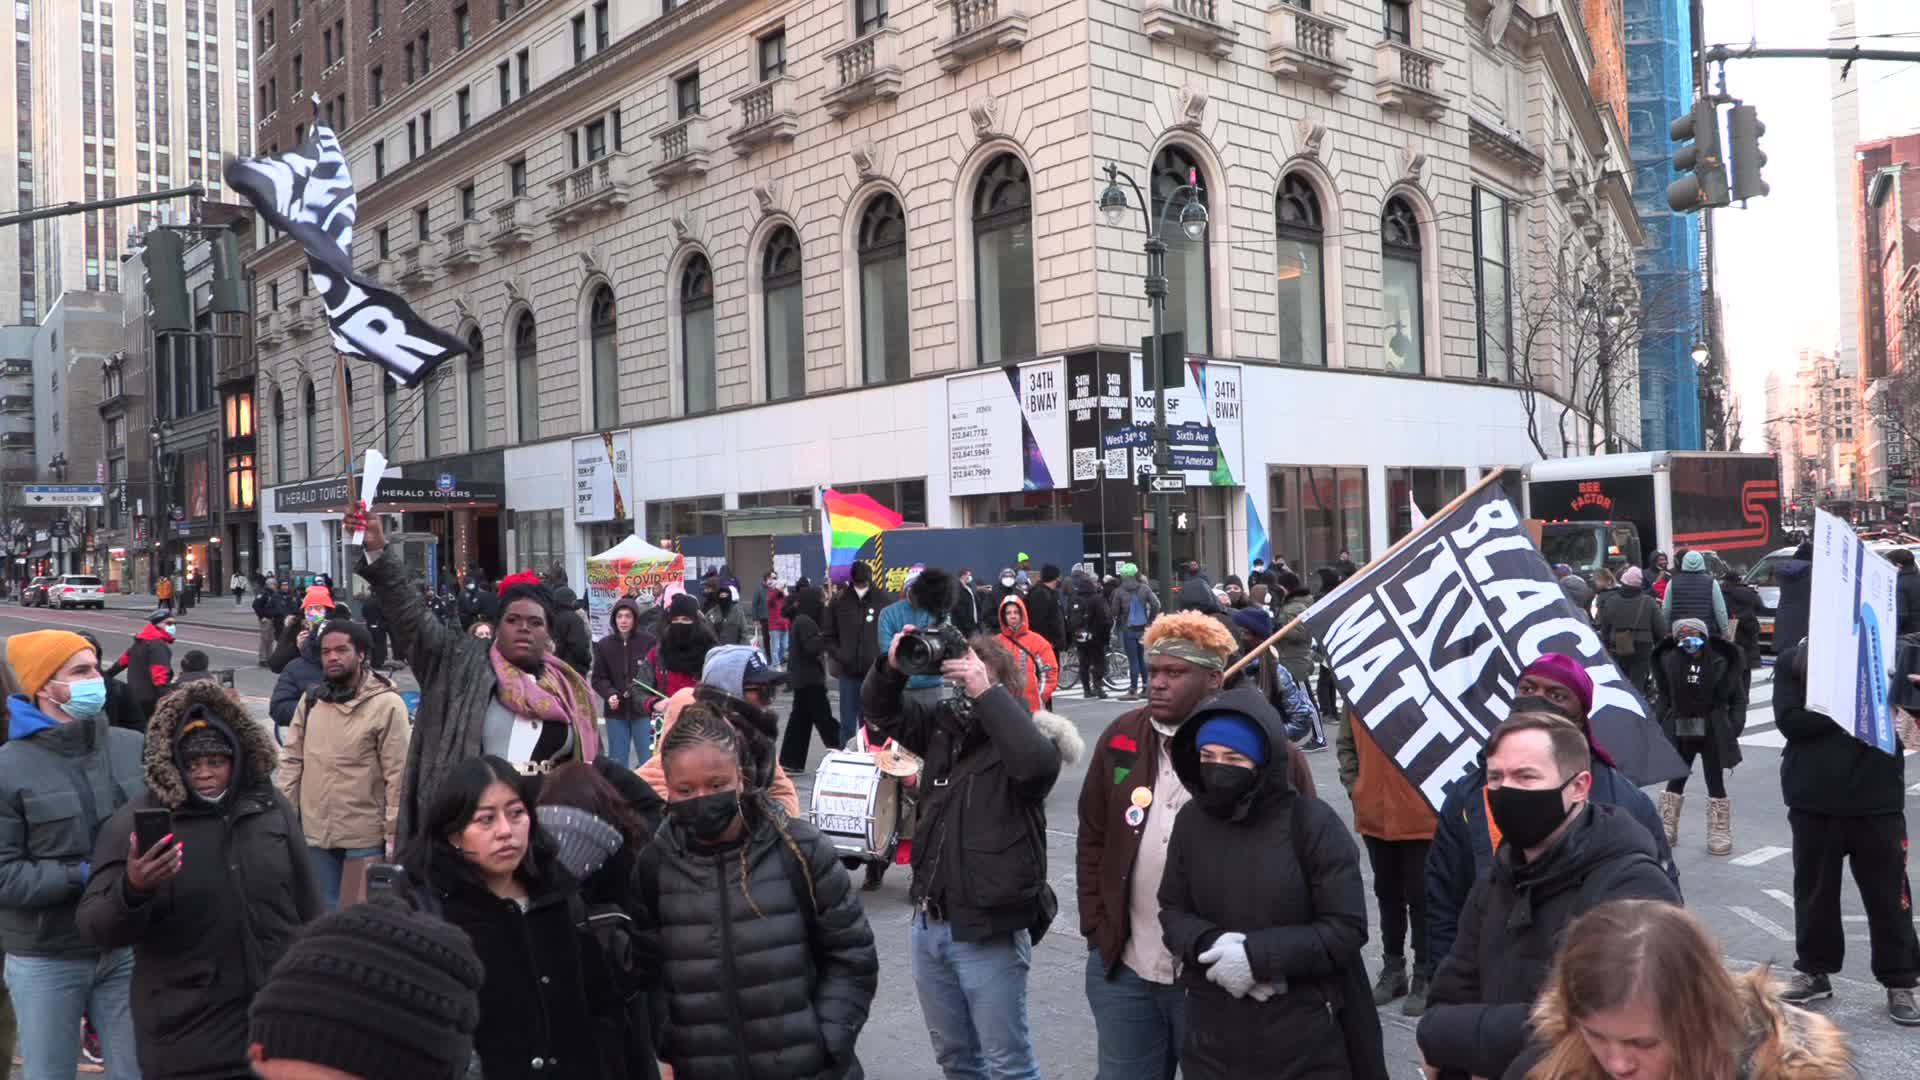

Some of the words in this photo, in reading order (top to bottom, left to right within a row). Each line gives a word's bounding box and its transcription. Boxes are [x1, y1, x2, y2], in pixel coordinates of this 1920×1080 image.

[1030, 371, 1053, 391] 34TH
[1215, 381, 1236, 399] 34TH
[1031, 392, 1058, 413] BWAY
[1167, 399, 1180, 410] SF
[1216, 402, 1240, 419] BWAY
[1105, 435, 1123, 446] West
[1125, 432, 1137, 444] 34th
[1139, 431, 1147, 441] St
[1176, 430, 1194, 441] Sixth
[1195, 432, 1209, 442] Ave
[1185, 456, 1214, 467] Americas
[382, 489, 424, 498] HERALD
[429, 490, 471, 498] TOWERS
[1579, 481, 1600, 493] SEE
[286, 490, 317, 505] HERALD
[1571, 493, 1612, 511] FACTOR
[1451, 499, 1647, 719] BLACK
[1378, 537, 1515, 732] LIVE
[1323, 594, 1483, 813] MATTE
[820, 816, 863, 831] MATTER
